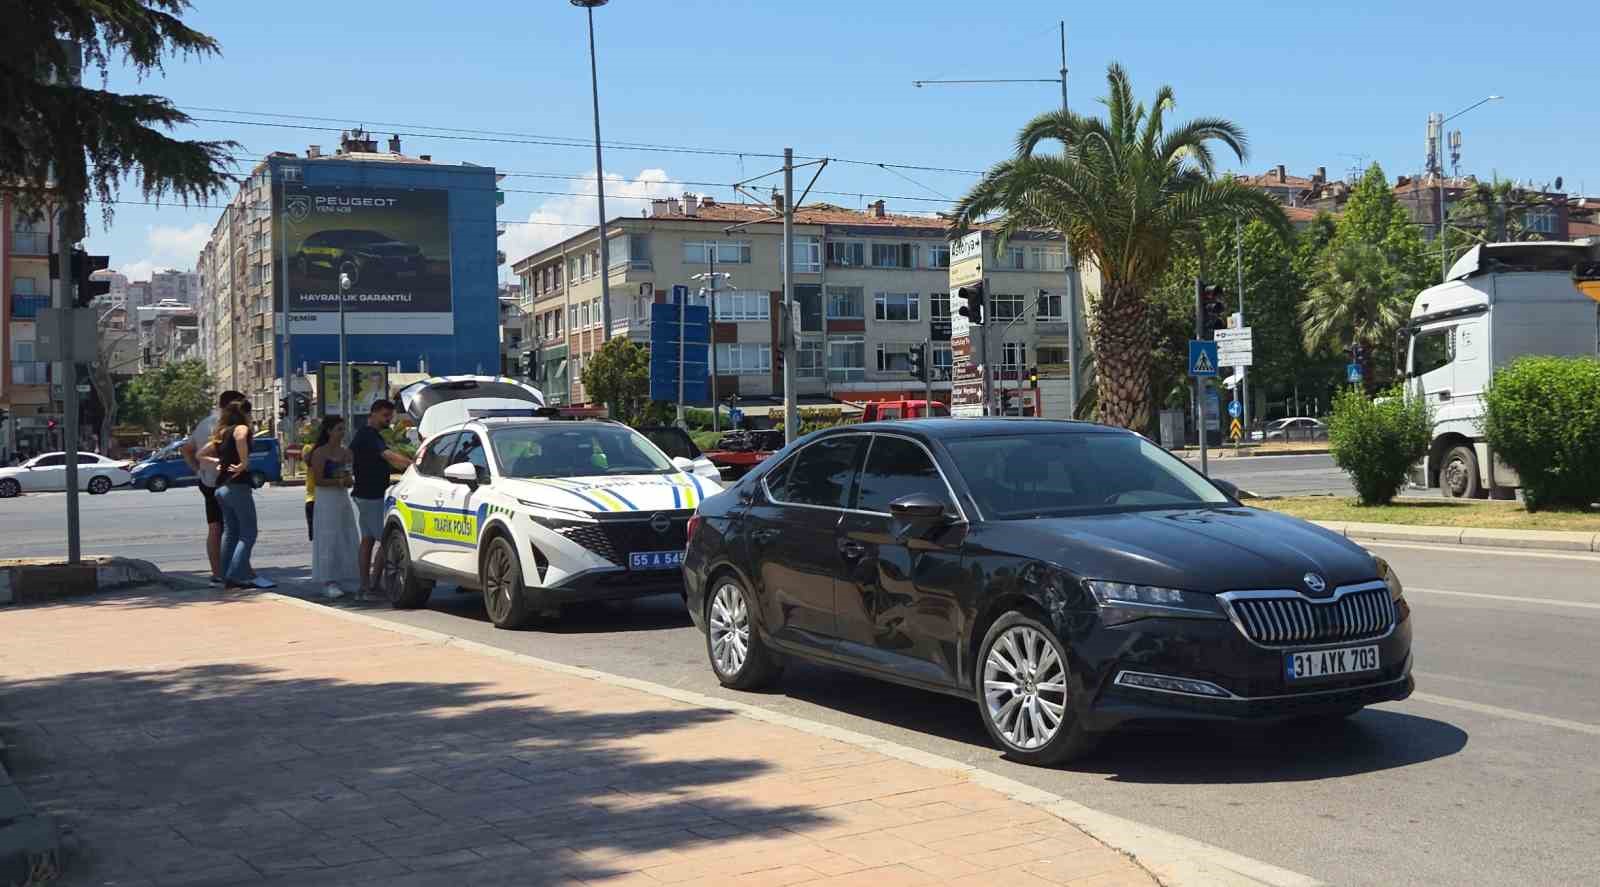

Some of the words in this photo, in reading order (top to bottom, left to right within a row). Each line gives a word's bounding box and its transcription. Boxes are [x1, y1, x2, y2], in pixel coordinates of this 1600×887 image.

[315, 196, 397, 206] PEUGEOT
[633, 554, 649, 566] 55
[653, 553, 660, 565] A
[1295, 654, 1313, 676] 31
[1320, 651, 1346, 674] AYK
[1351, 648, 1376, 670] 703
